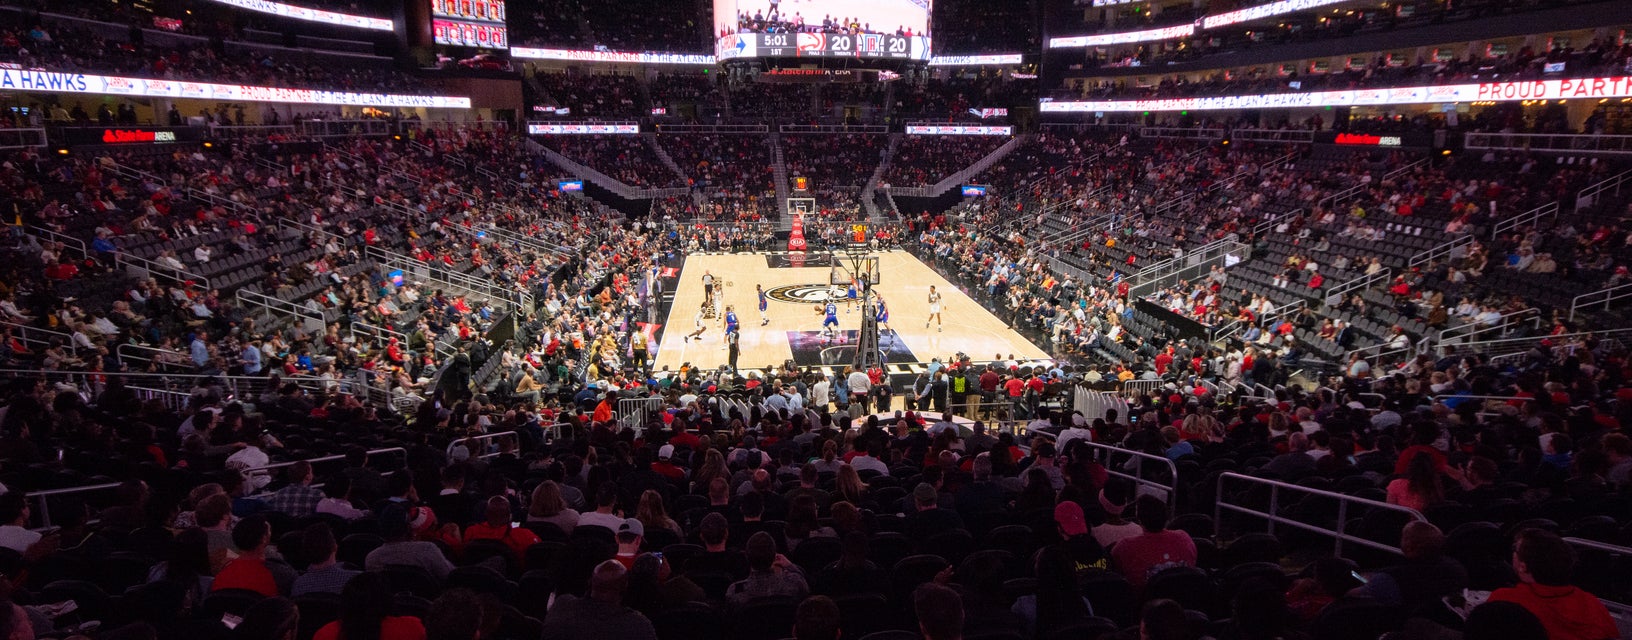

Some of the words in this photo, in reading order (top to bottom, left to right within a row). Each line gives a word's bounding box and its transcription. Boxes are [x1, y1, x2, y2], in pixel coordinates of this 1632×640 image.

[764, 35, 787, 46] 5:01
[831, 36, 851, 51] 20
[889, 37, 907, 53] 20
[771, 48, 783, 56] 1ST
[21, 71, 87, 91] HAWKS
[1478, 81, 1547, 99] PROUD
[154, 131, 176, 142] ARENA
[1379, 136, 1401, 145] ARENA
